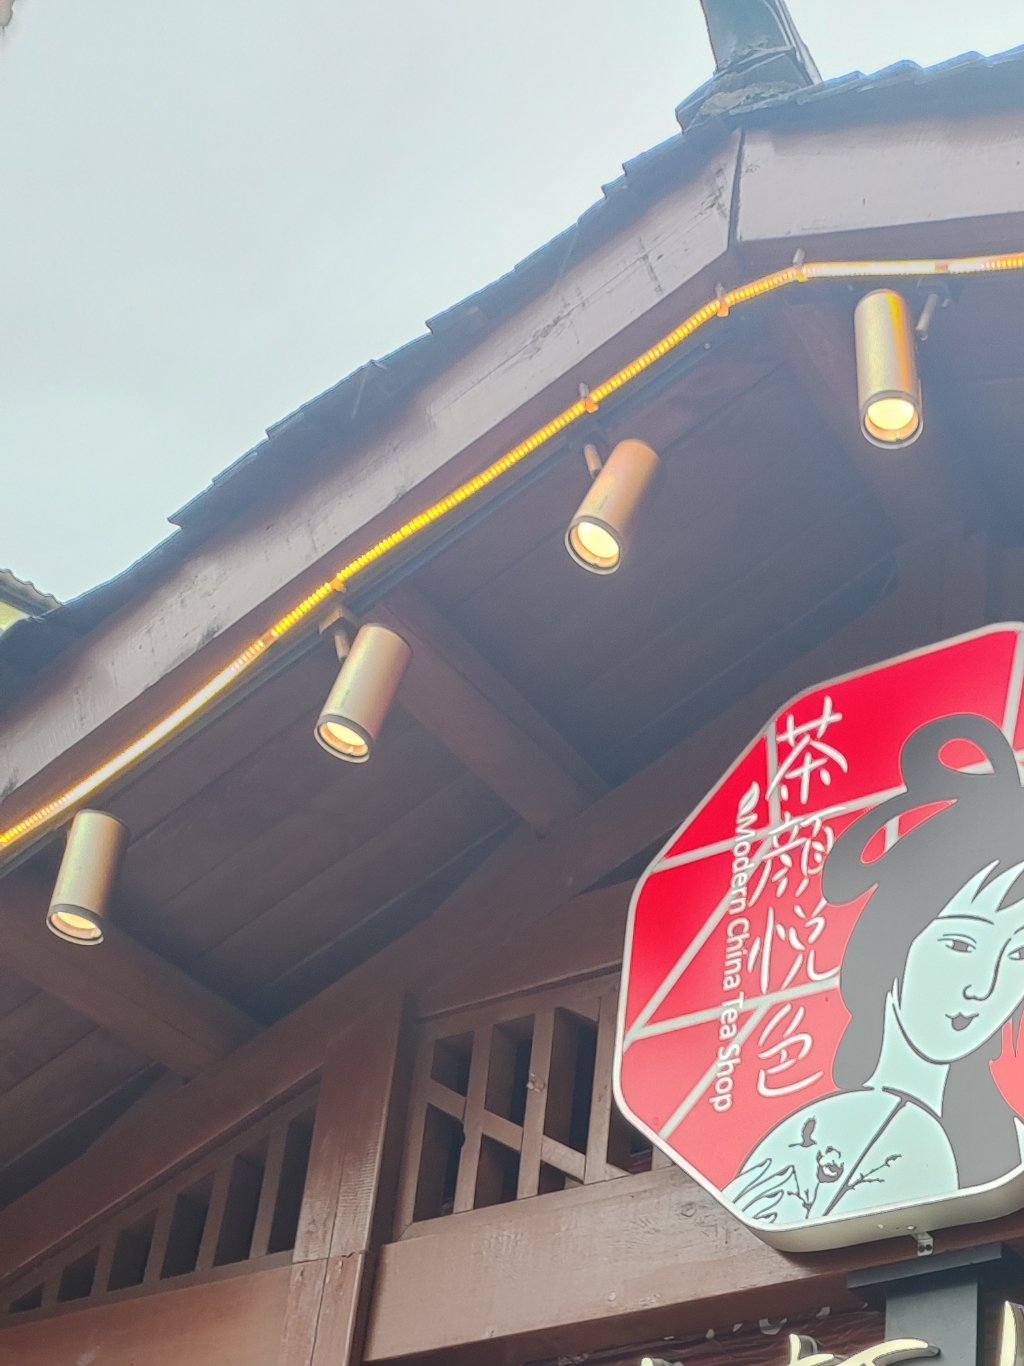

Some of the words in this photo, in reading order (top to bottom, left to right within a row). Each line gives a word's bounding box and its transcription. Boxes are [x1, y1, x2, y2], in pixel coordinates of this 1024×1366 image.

[727, 811, 758, 915] Modern
[722, 917, 750, 991] China
[719, 991, 745, 1041] Tea
[709, 1043, 742, 1112] Shop
